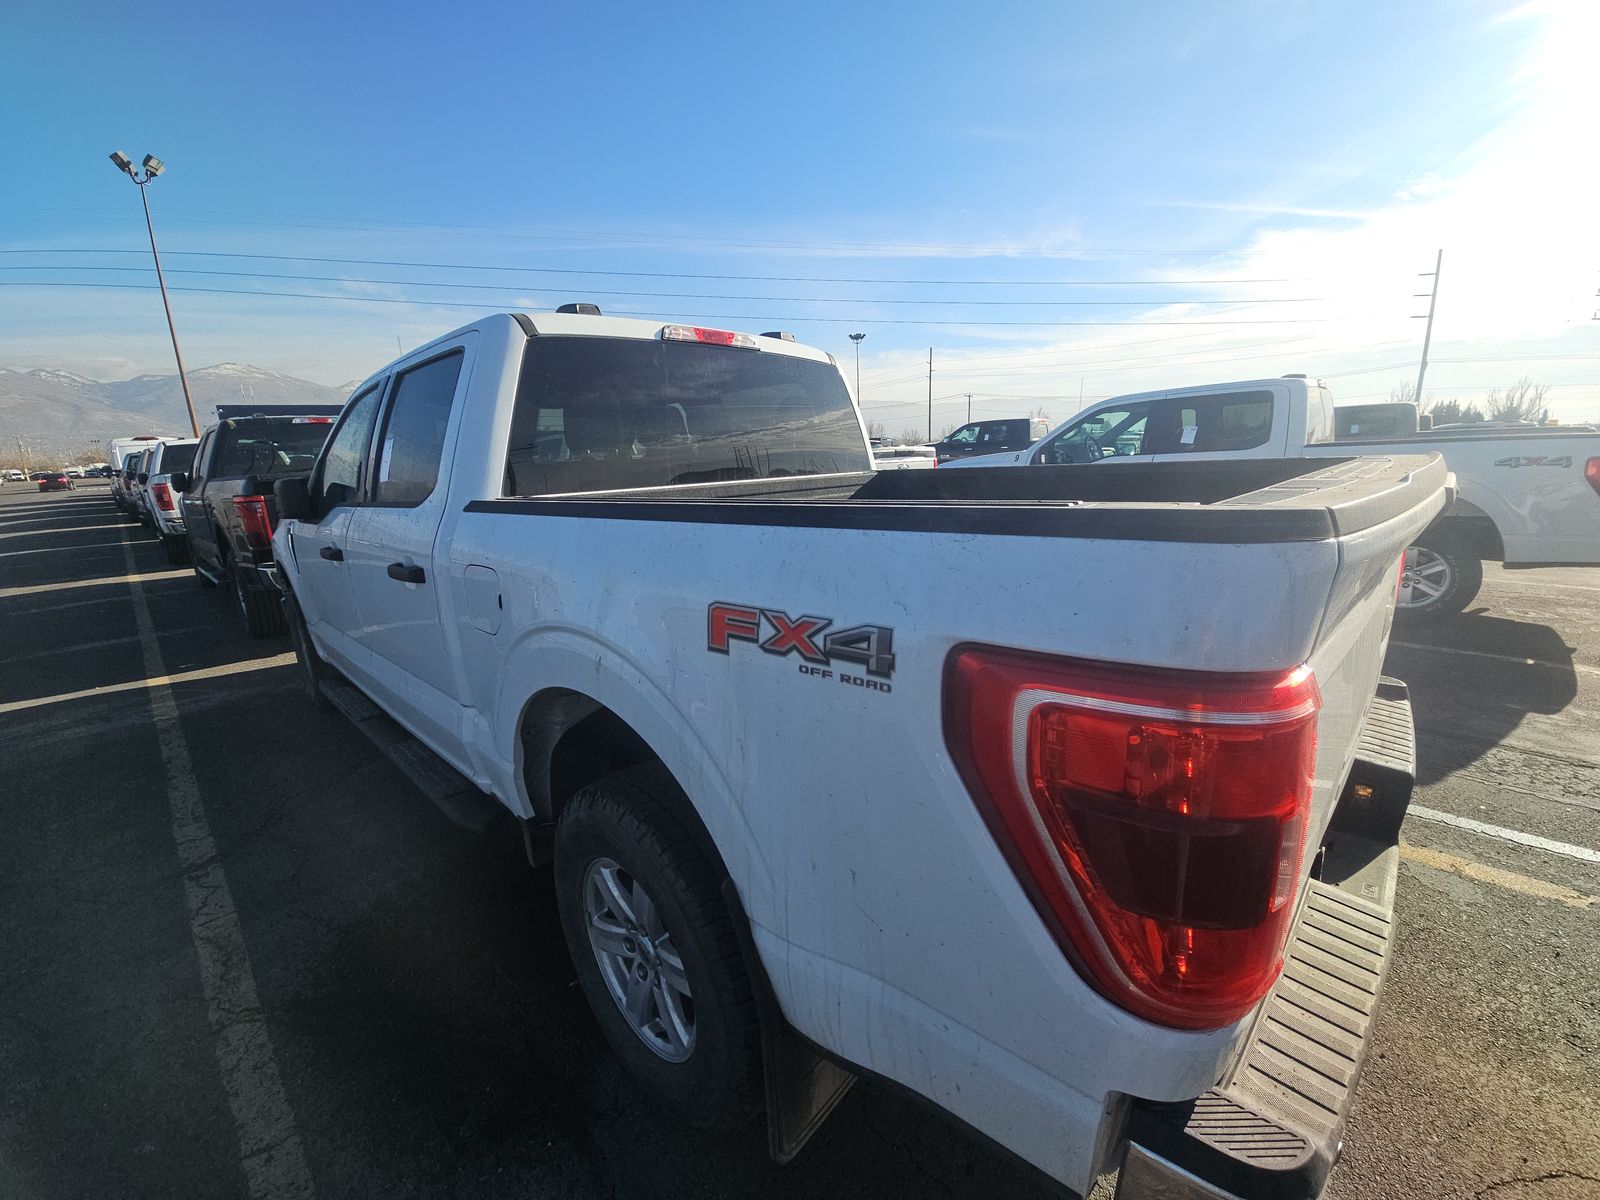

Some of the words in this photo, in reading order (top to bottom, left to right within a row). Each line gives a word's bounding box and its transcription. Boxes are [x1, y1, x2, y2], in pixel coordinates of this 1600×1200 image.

[707, 600, 896, 680] FX4
[799, 664, 833, 679] OFF
[840, 673, 892, 693] ROAD
